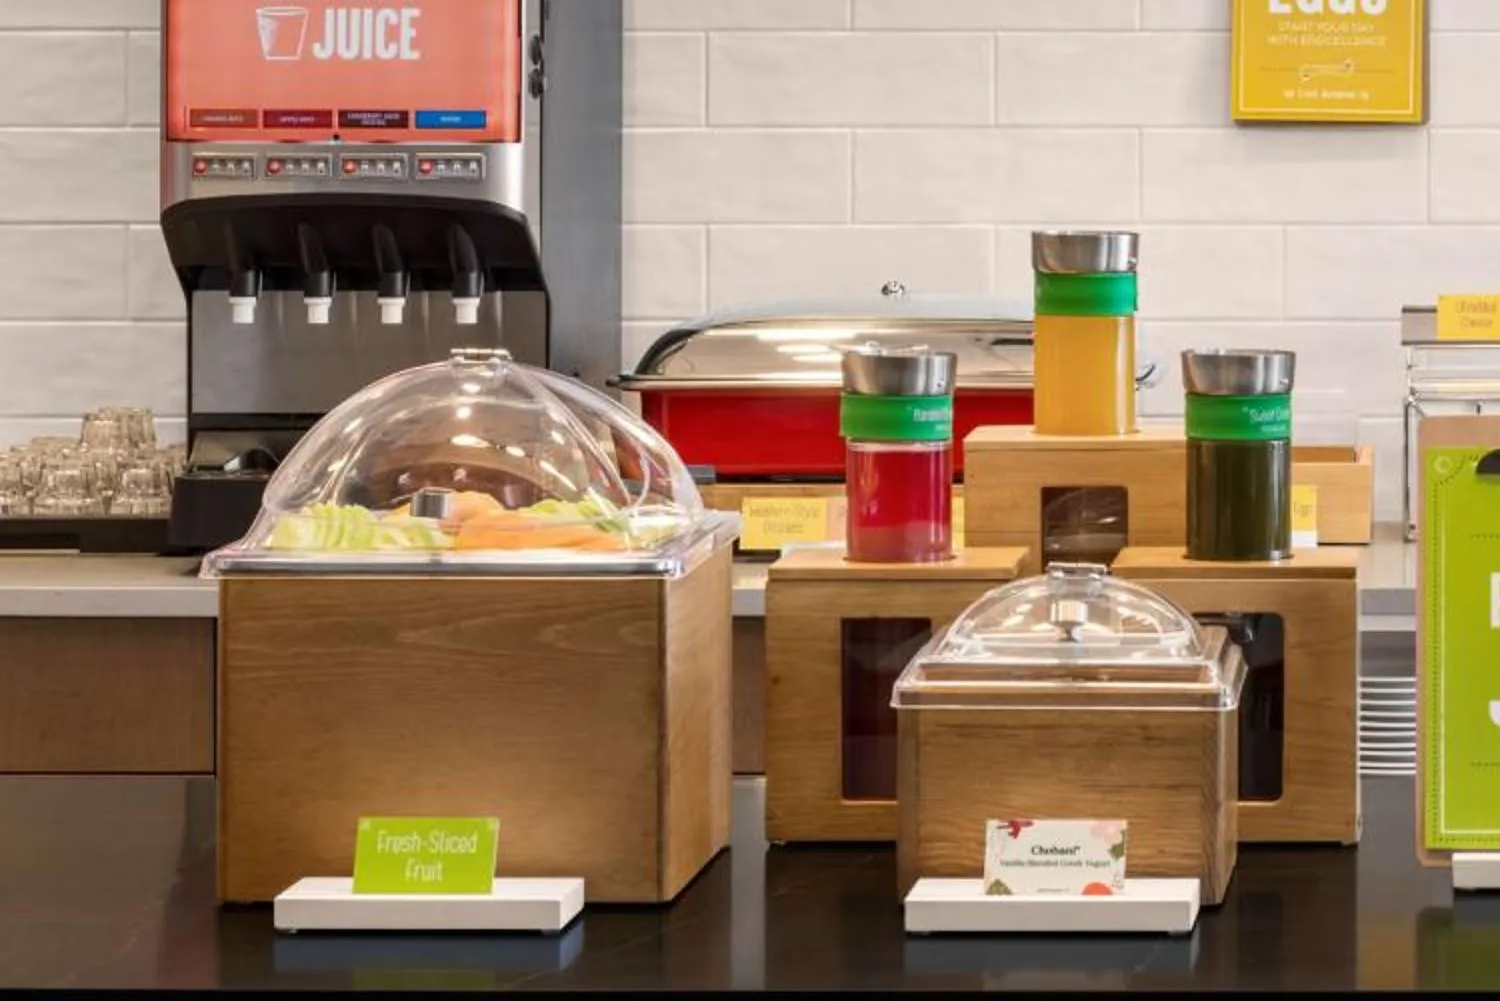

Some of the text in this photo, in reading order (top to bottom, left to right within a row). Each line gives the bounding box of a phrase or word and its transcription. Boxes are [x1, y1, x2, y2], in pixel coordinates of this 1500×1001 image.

[312, 7, 421, 60] JUICE
[377, 829, 478, 854] Fresh-Sliced
[405, 858, 443, 882] Fruit
